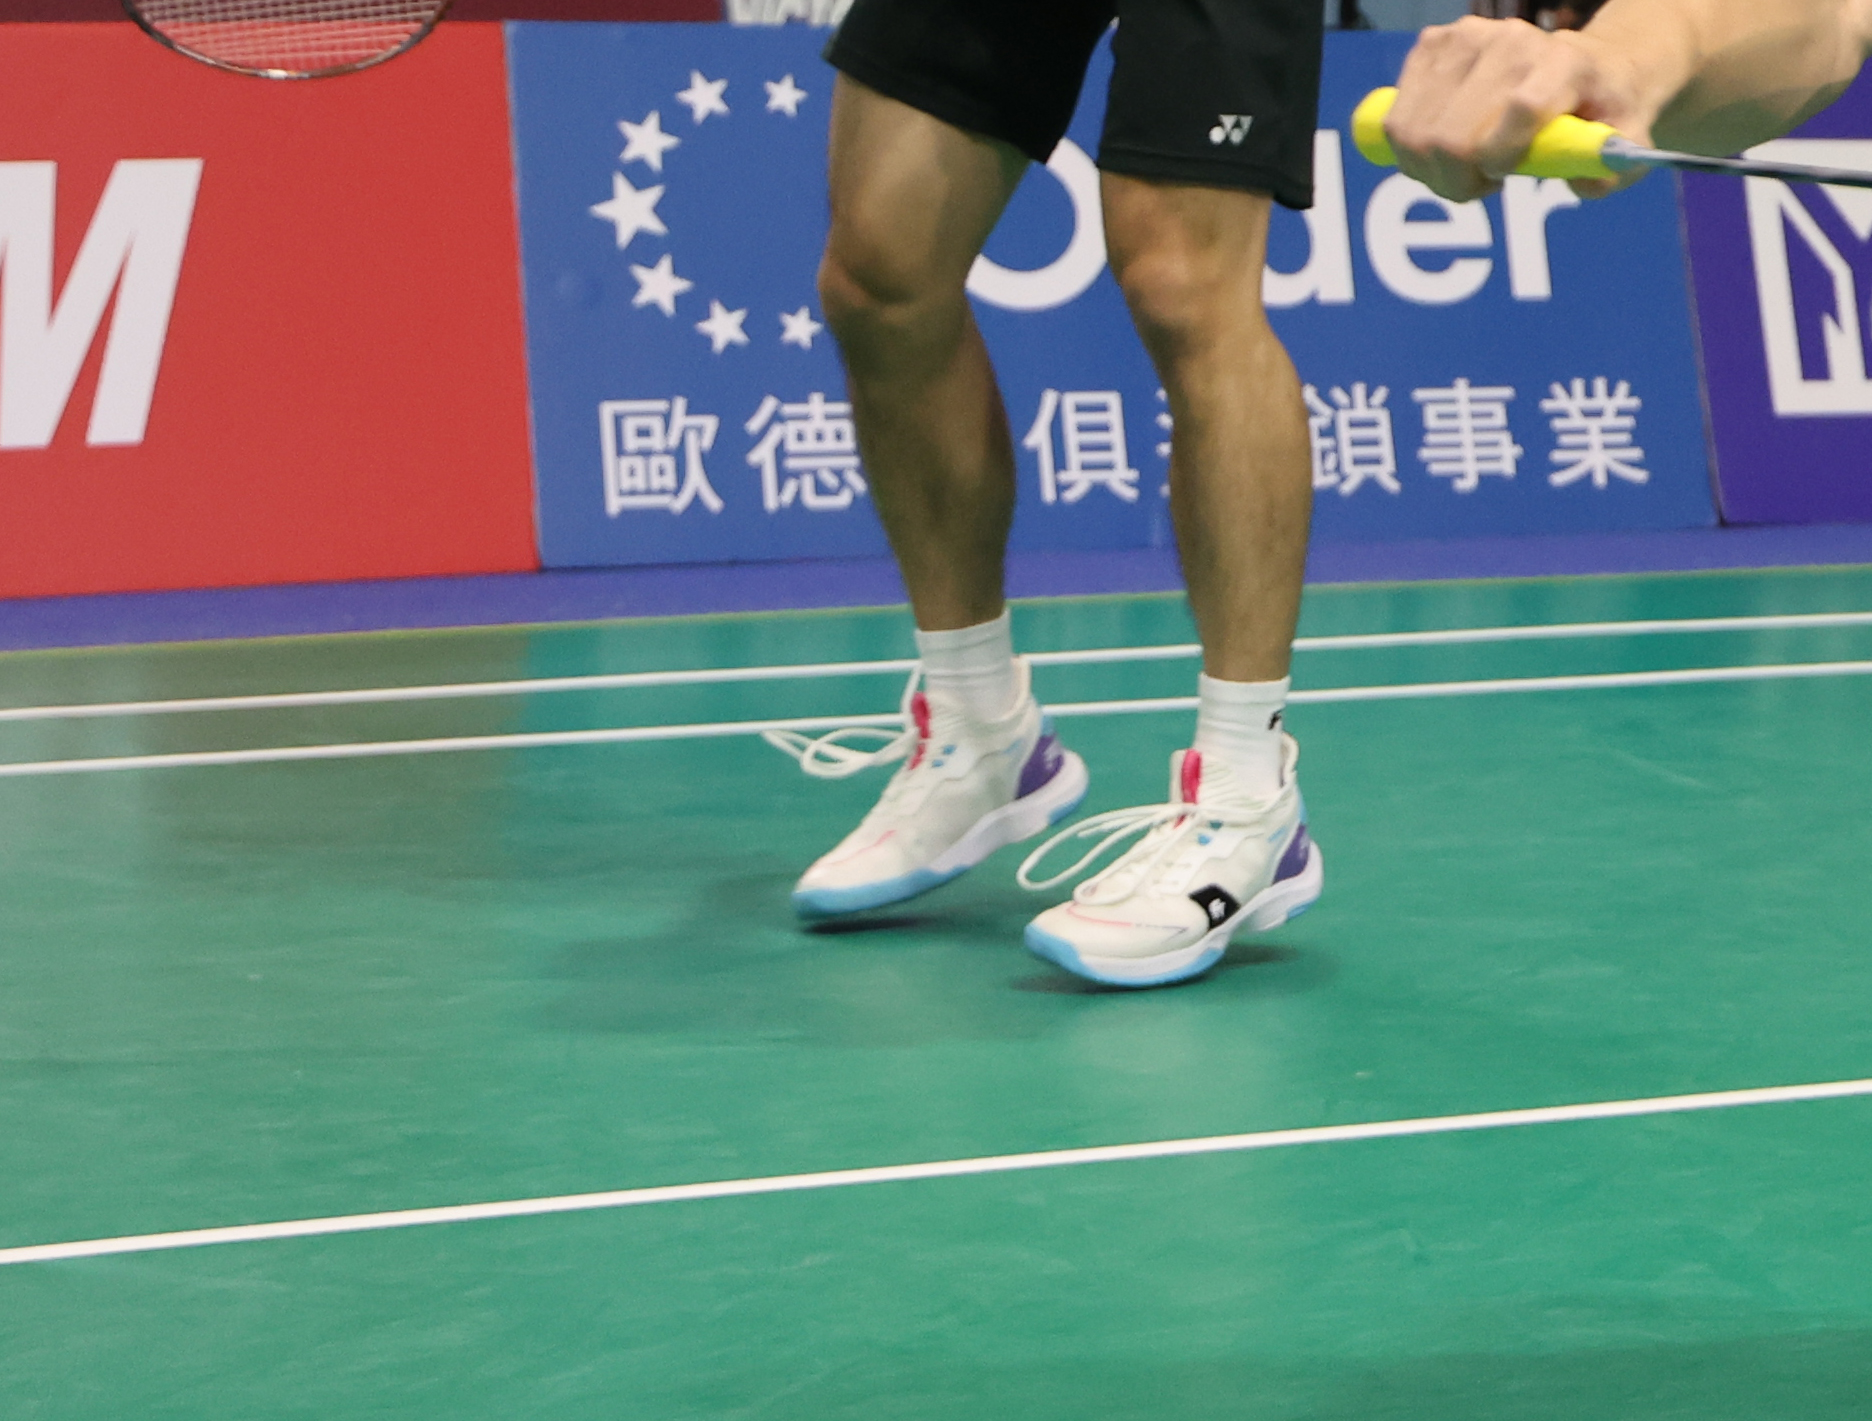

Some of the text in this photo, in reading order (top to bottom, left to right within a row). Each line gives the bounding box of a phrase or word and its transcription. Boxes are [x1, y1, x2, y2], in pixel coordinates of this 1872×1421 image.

[966, 129, 1581, 310] Oder
[600, 377, 1650, 517] 歐德俱鎖事業
